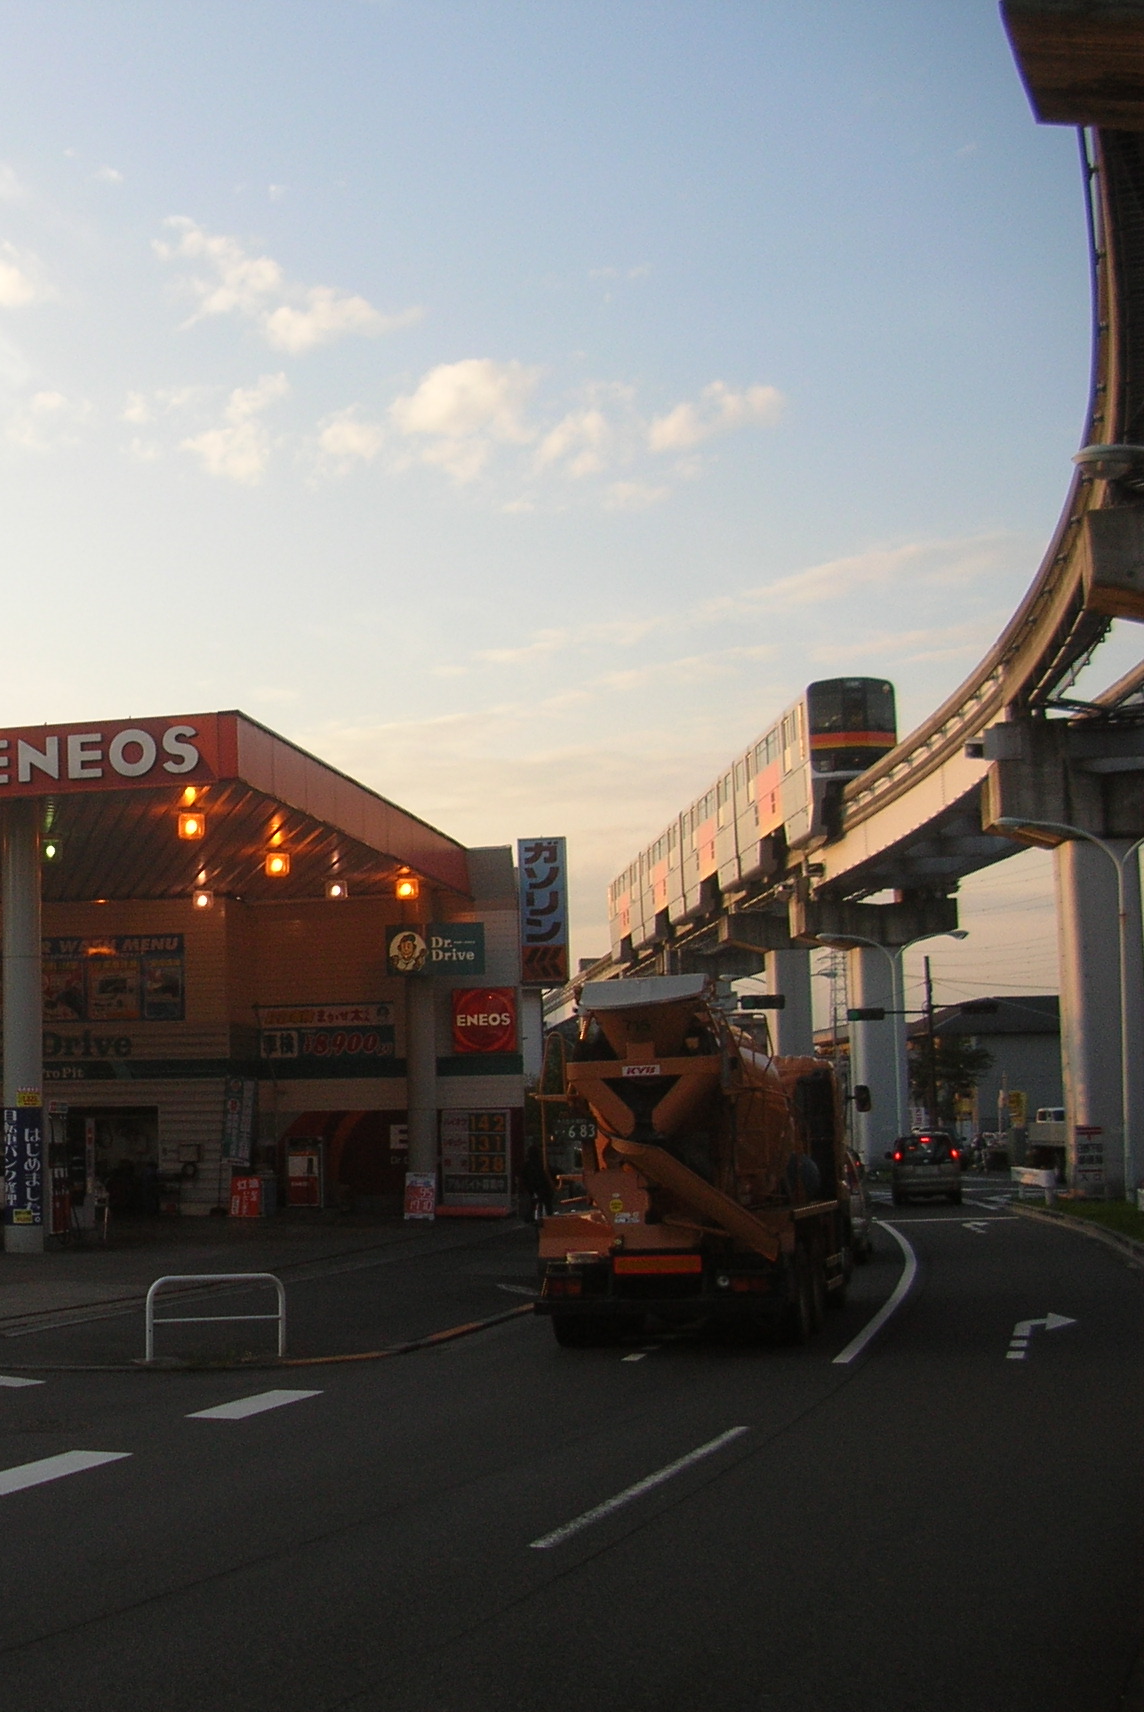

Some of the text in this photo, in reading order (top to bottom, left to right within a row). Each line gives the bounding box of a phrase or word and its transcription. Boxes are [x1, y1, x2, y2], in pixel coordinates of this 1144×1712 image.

[524, 841, 562, 943] ガソリン
[122, 936, 179, 951] MENU
[430, 936, 453, 949] Dr.
[430, 948, 475, 961] Drive
[456, 1012, 512, 1027] ENEOS
[470, 1114, 505, 1132] 142
[470, 1135, 502, 1151] 131
